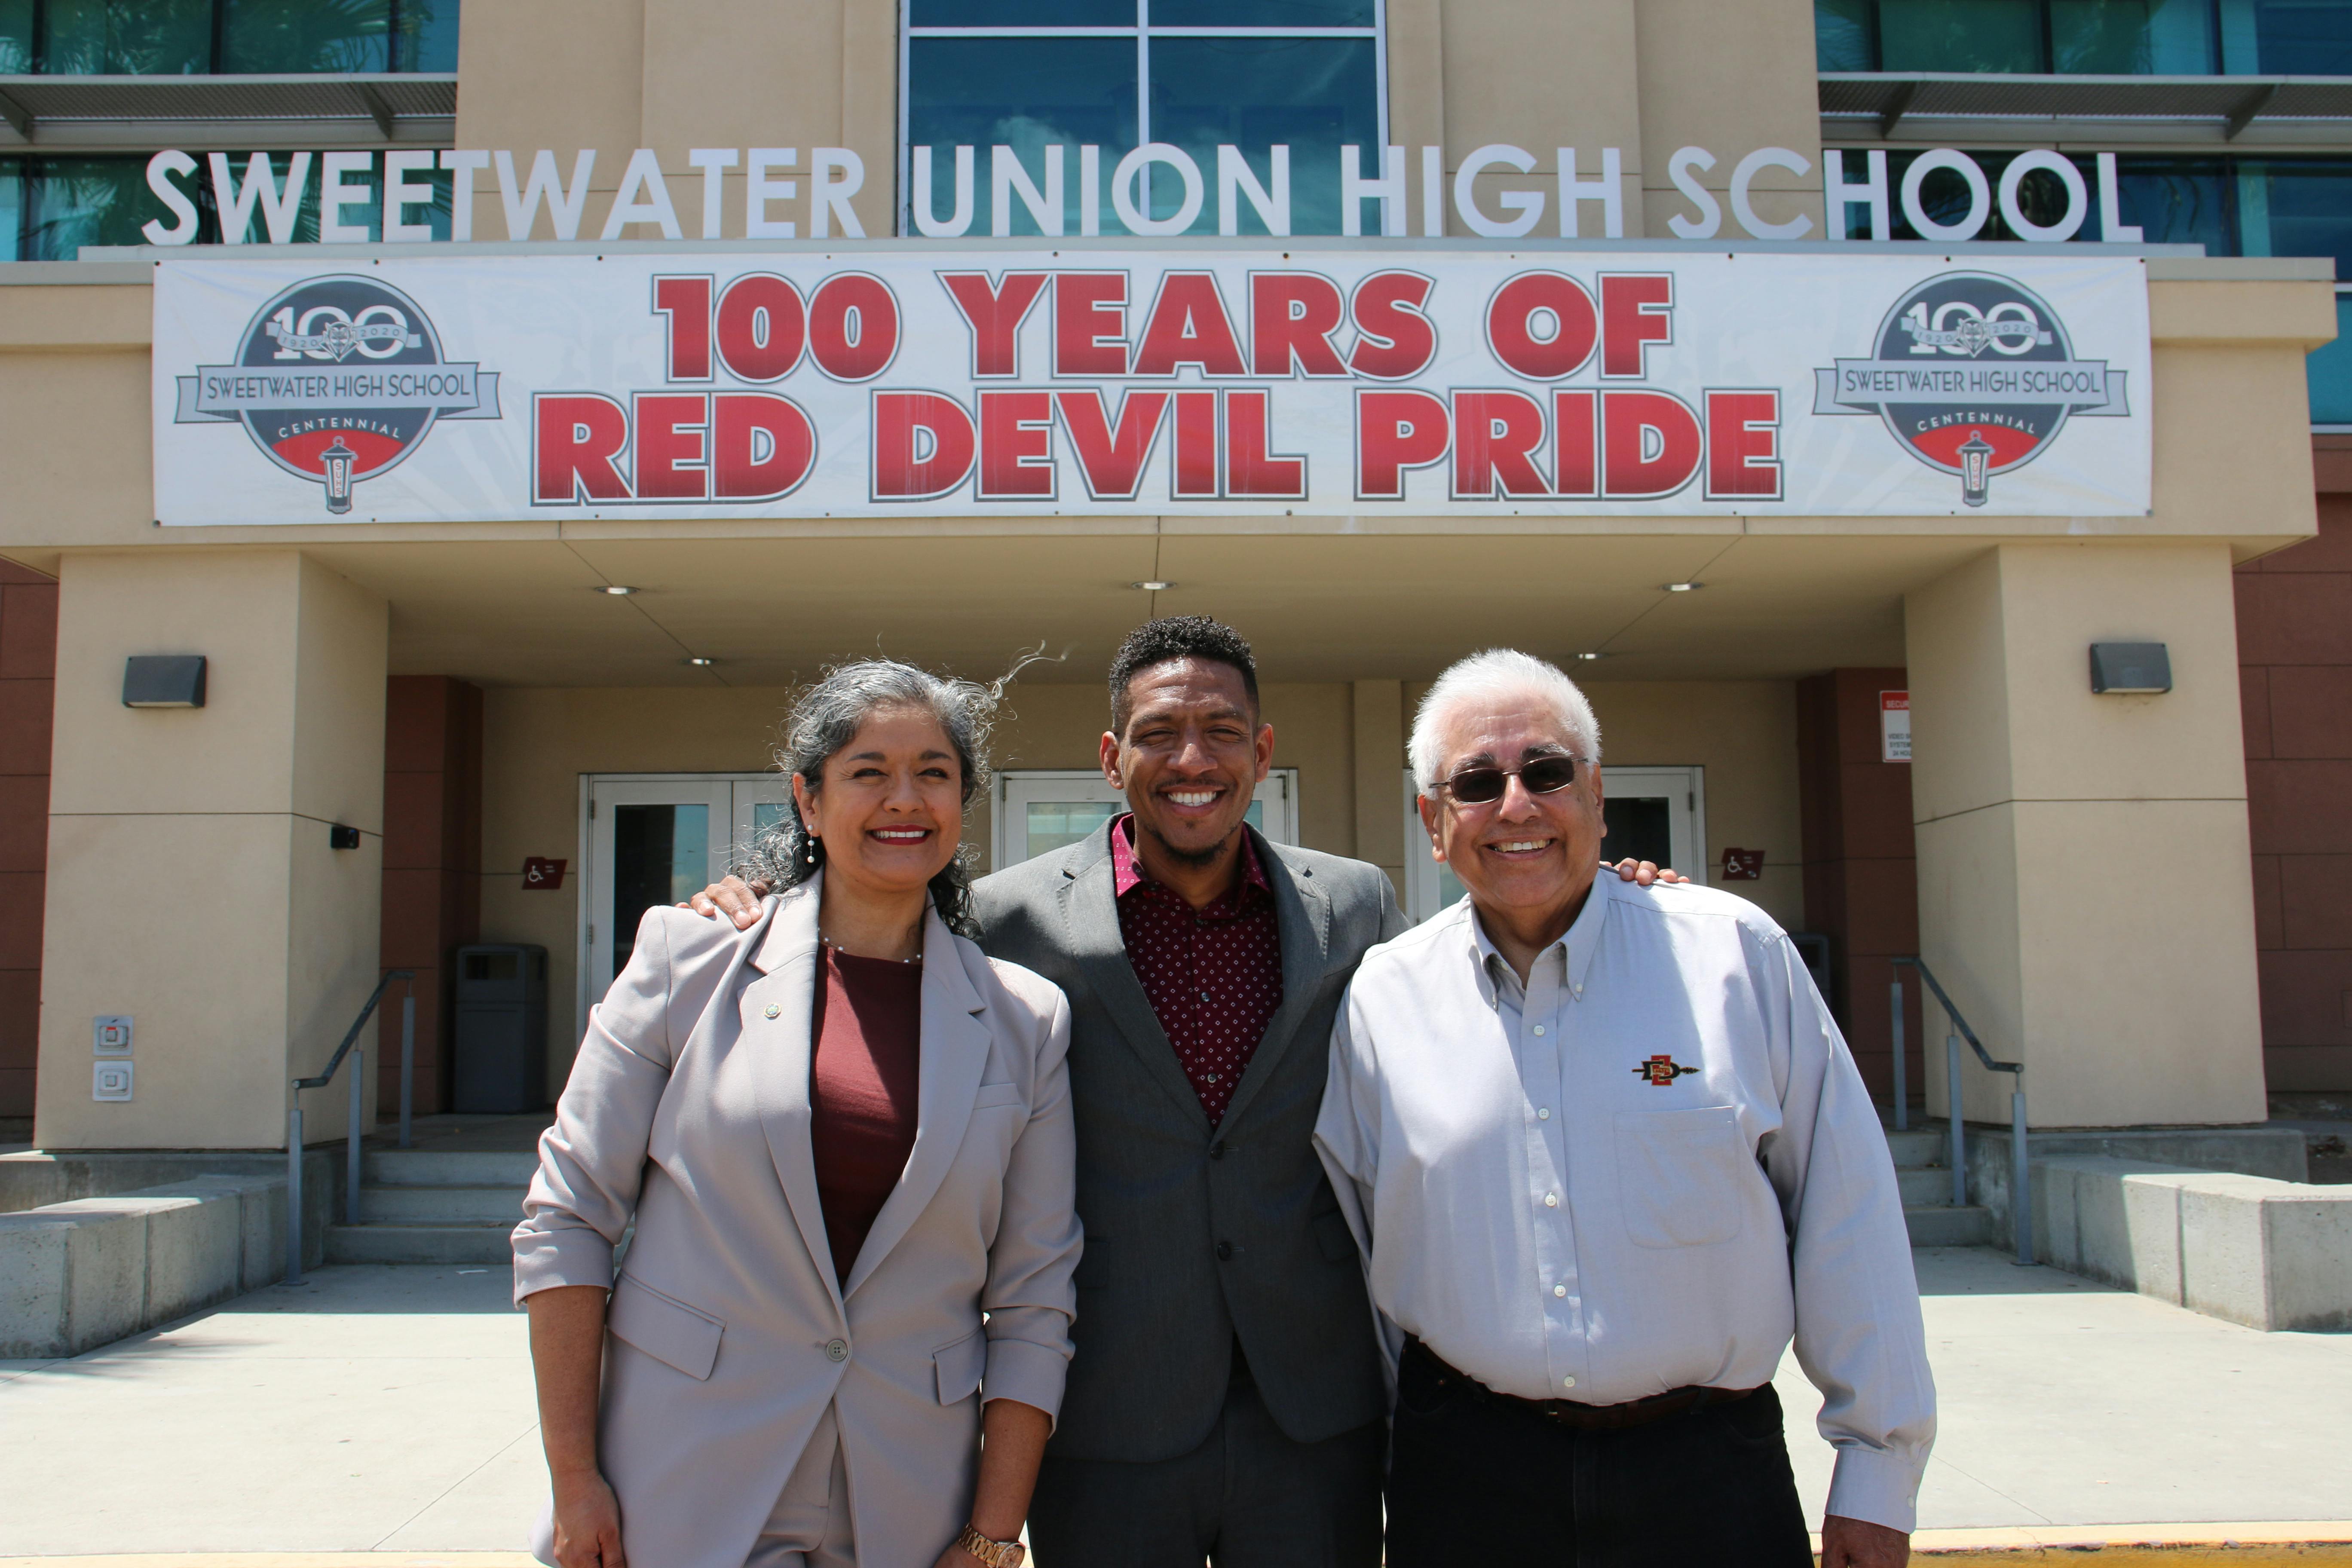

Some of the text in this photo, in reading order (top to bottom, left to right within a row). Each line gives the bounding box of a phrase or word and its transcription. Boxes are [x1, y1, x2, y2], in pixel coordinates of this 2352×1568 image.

[141, 142, 2144, 245] SWEETWATER UNION HIGH SCHOOL
[273, 305, 408, 360] 100
[360, 328, 400, 337] 2020
[651, 269, 1675, 384] 100 YEARS OF
[1907, 301, 2039, 355] 100
[1917, 332, 1951, 342] 1920
[1993, 324, 2032, 334] 2020
[282, 337, 318, 347] 1920
[208, 374, 470, 399] SWEETWATER HIGH SCHOOL
[1846, 370, 2100, 393] SWEETWATER HIGH SCHOOL
[279, 417, 399, 439] CENTENNIAL
[1917, 412, 2035, 434] CENTENNIAL
[531, 386, 1784, 506] RED DEVIL PRIDE
